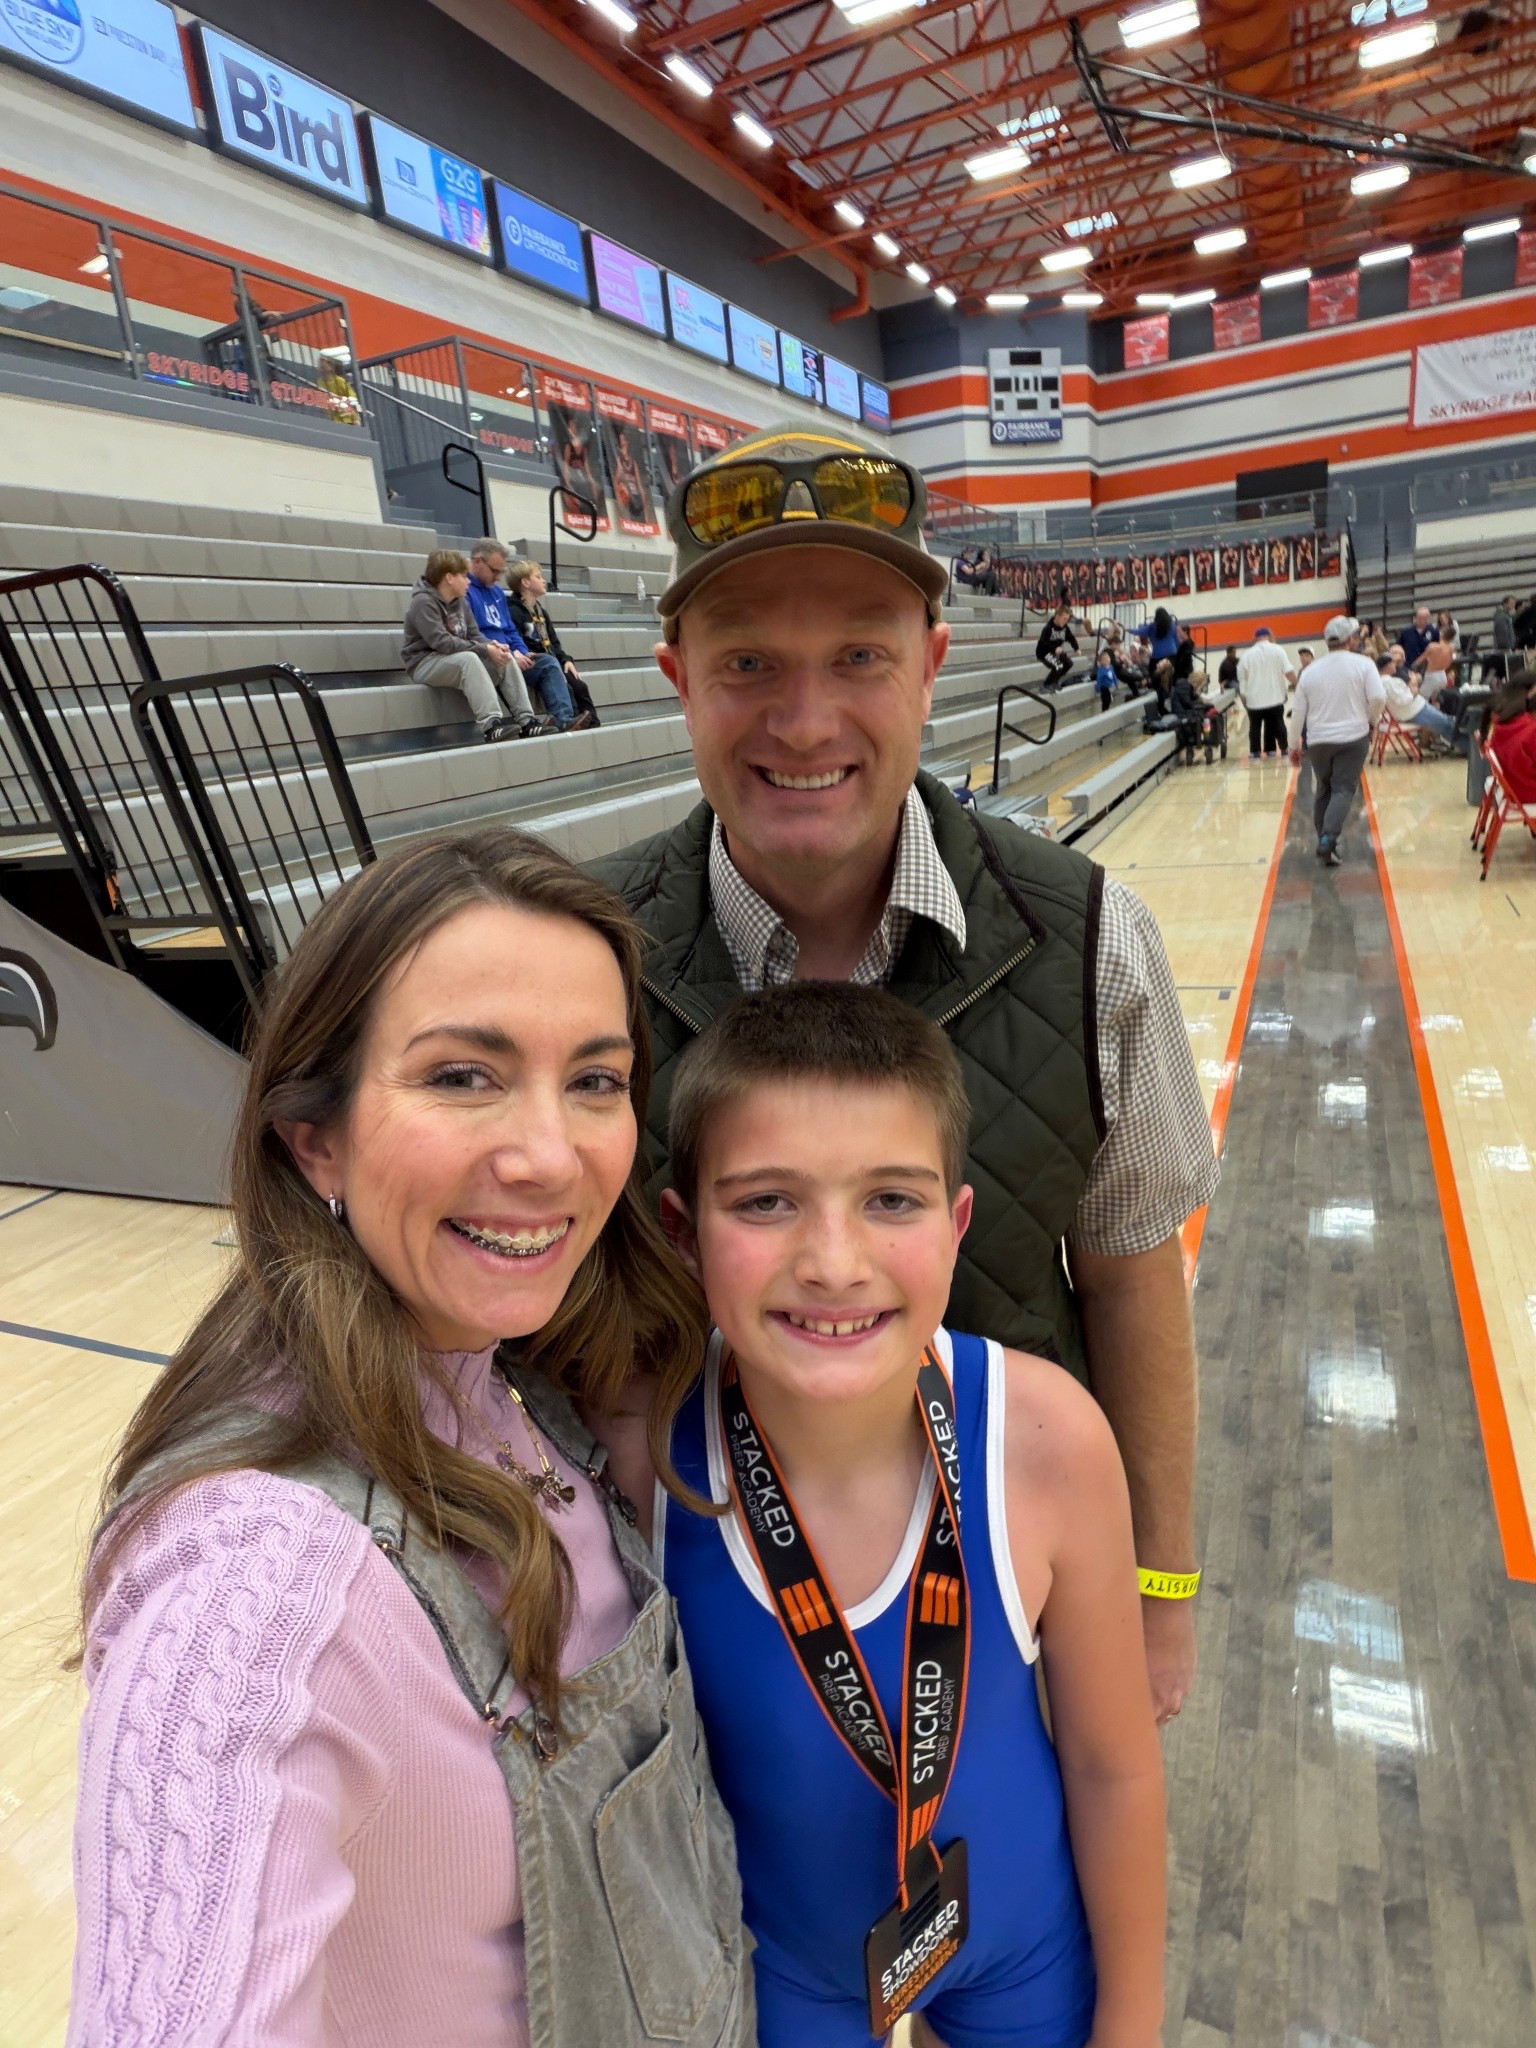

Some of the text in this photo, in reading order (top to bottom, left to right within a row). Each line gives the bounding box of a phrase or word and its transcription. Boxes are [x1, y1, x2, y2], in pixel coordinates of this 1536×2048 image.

[5, 0, 48, 31] BLUE
[50, 23, 75, 43] SKY
[221, 55, 352, 189] Bird
[440, 157, 477, 194] G2G
[147, 351, 356, 416] SKYRIDGE STUDE
[730, 1433, 769, 1534] PREP ACADEMY
[733, 1411, 796, 1548] STACKED
[818, 1673, 870, 1752] PREP ACADEMY
[825, 1650, 892, 1767] STACKED
[912, 1660, 943, 1785] STACKED
[936, 1678, 956, 1761] PREP ACADEMY
[881, 1899, 959, 1989] STACKED
[882, 1912, 960, 2004] SHOWDOWN
